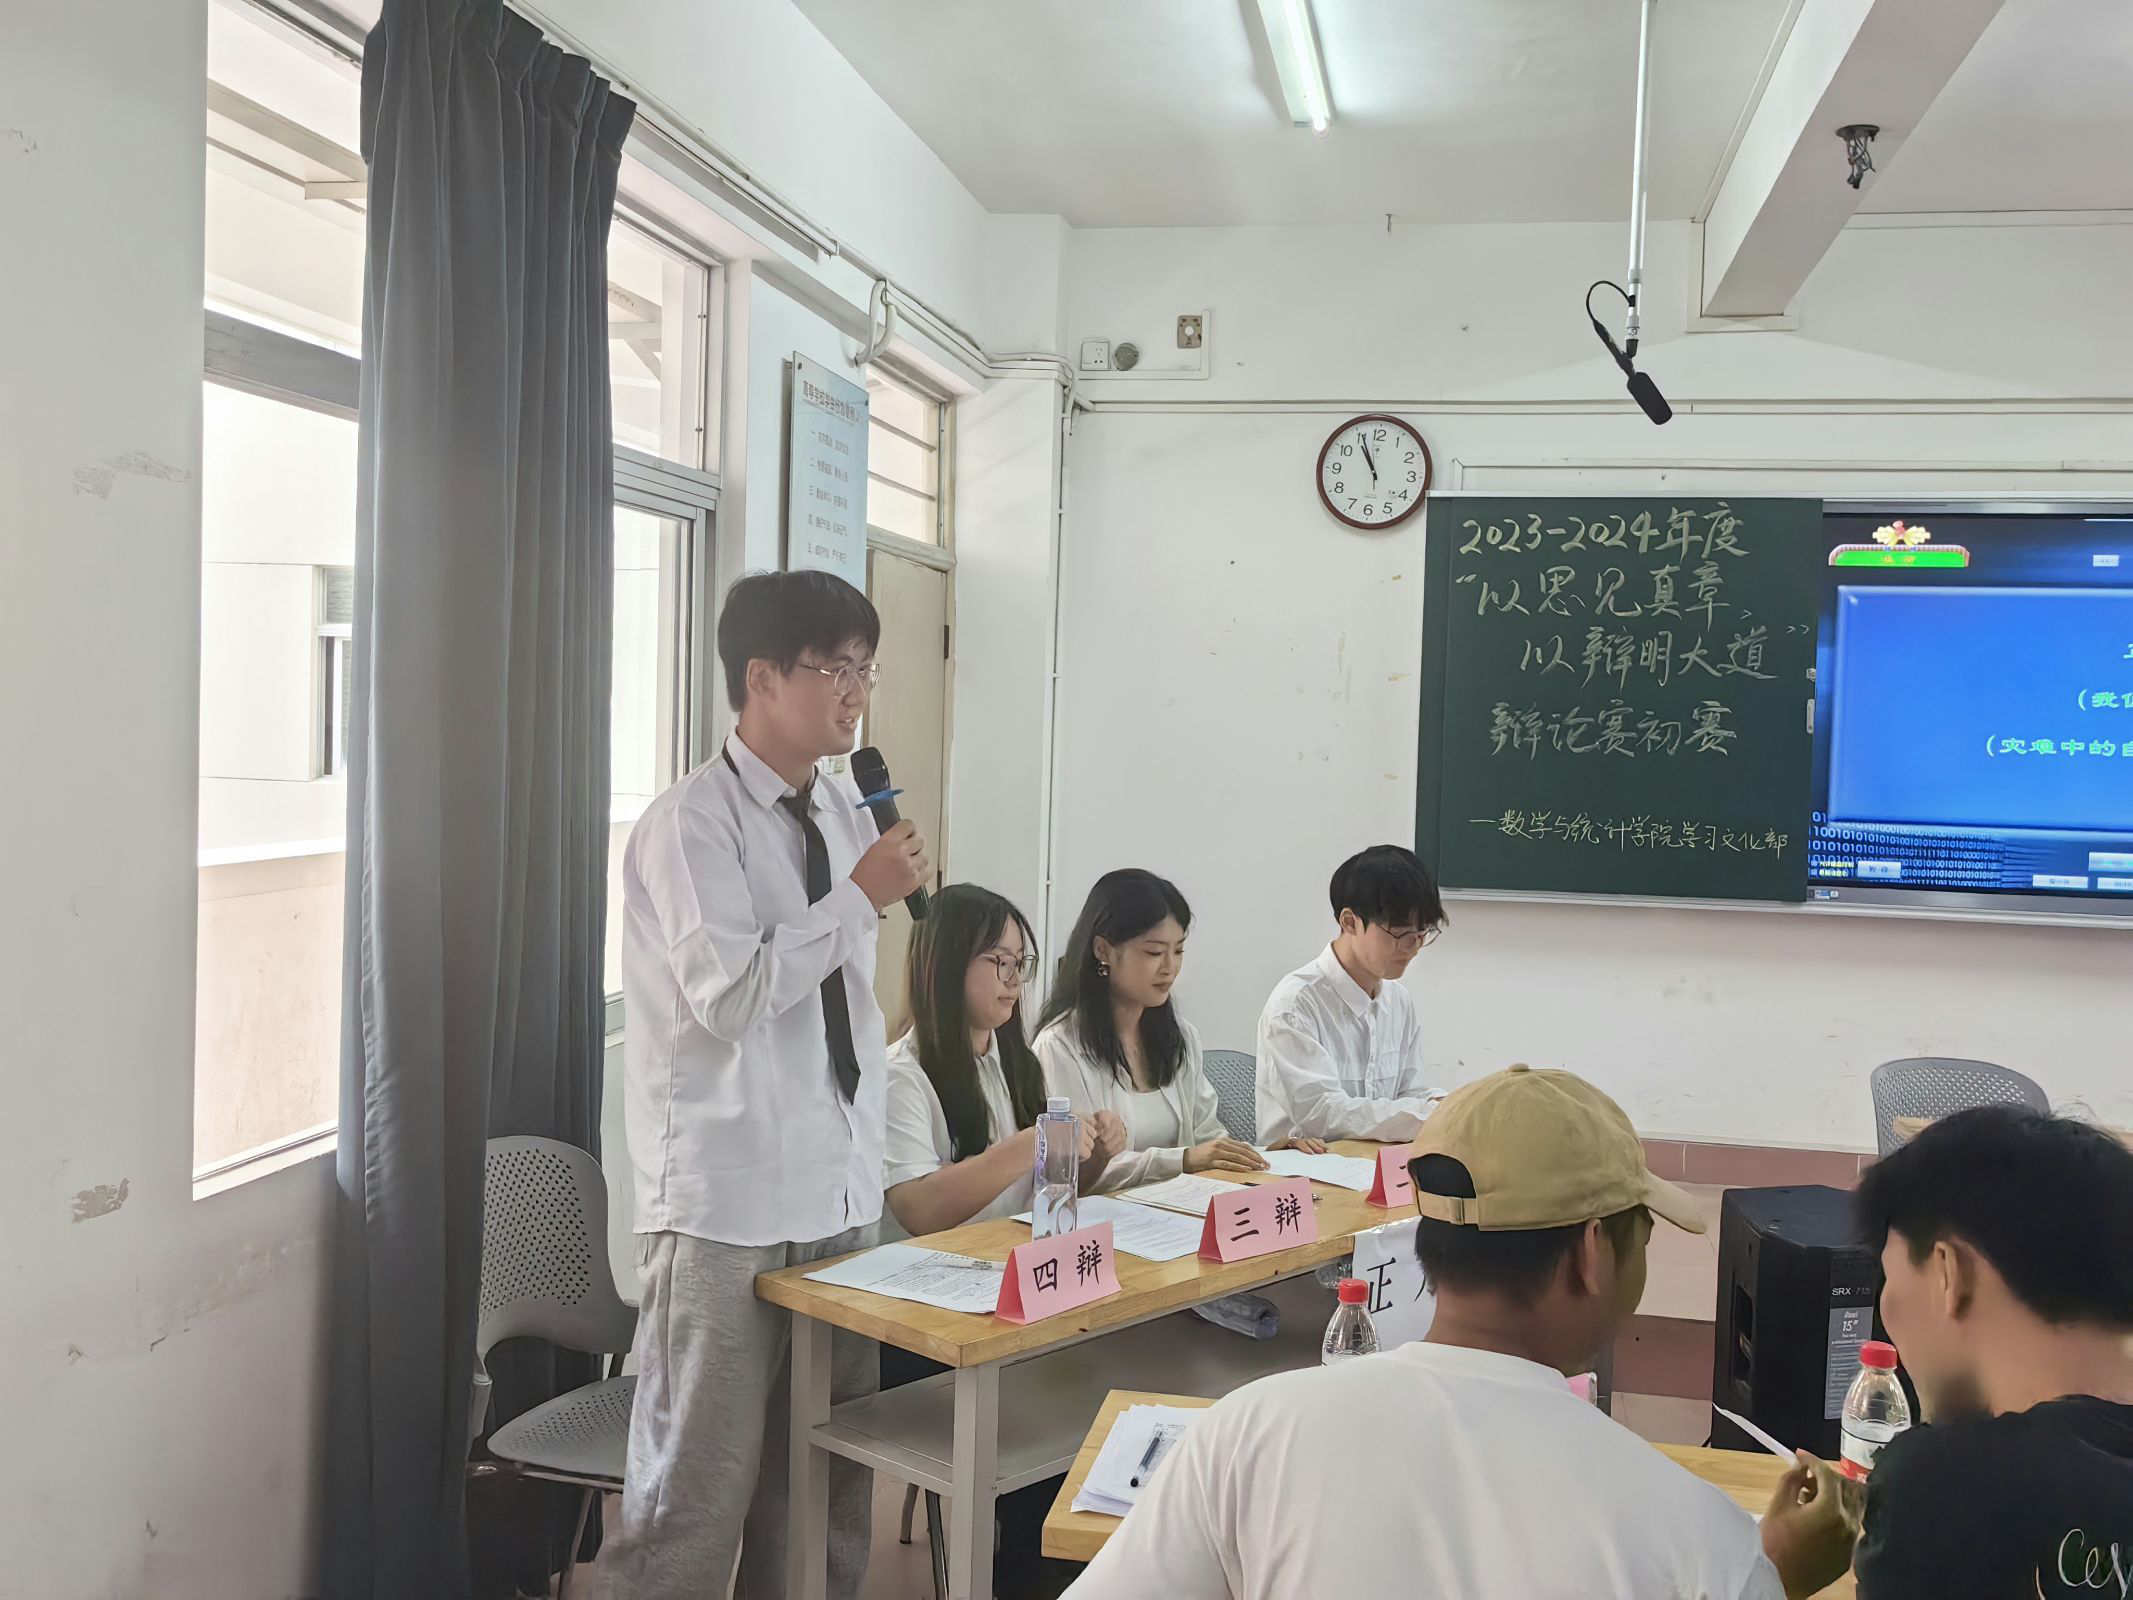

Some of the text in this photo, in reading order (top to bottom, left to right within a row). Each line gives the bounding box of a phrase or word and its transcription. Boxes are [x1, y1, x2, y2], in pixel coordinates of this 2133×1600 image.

[1373, 429, 1387, 441] 12
[1395, 436, 1400, 448] 1
[1340, 444, 1353, 457] 10
[1403, 451, 1415, 464] 2
[1331, 462, 1342, 475] 9
[1406, 470, 1417, 483] 3
[1334, 481, 1344, 494] 8
[1398, 489, 1408, 501] 4
[1348, 497, 1358, 510] 7
[1363, 503, 1374, 516] 6
[1382, 502, 1393, 514] 5
[1459, 501, 1750, 562] 2023-2024年度
[1489, 699, 1738, 760] 辩论赛初赛
[1230, 1192, 1302, 1242] 三辩
[1032, 1239, 1103, 1294] 四辩
[1831, 1287, 1852, 1296] SRX
